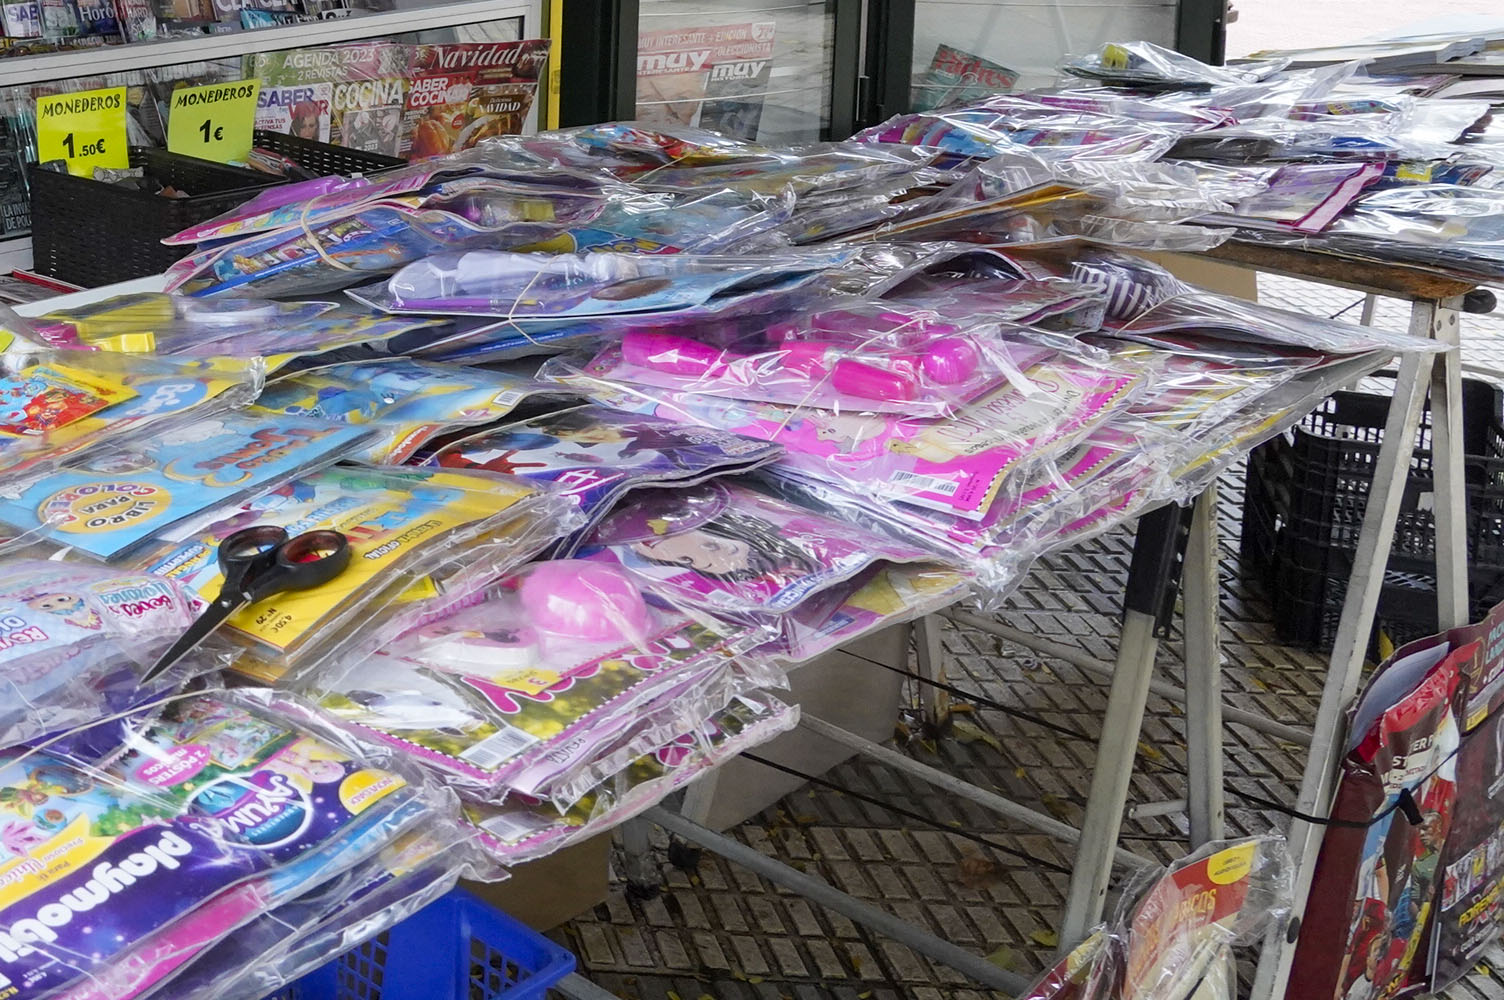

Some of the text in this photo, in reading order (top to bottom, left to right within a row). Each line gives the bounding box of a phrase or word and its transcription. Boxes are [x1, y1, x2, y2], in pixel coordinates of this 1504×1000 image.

[282, 48, 375, 70] AGENDA 2023
[432, 43, 524, 70] Navidad
[305, 66, 348, 80] REVISTAS
[42, 92, 122, 119] MONEDEROS
[175, 84, 254, 111] MONEDEROS
[334, 80, 404, 110] COCINA
[199, 119, 224, 144] 1€
[80, 495, 129, 514] PARA
[85, 498, 156, 529] LIBRO
